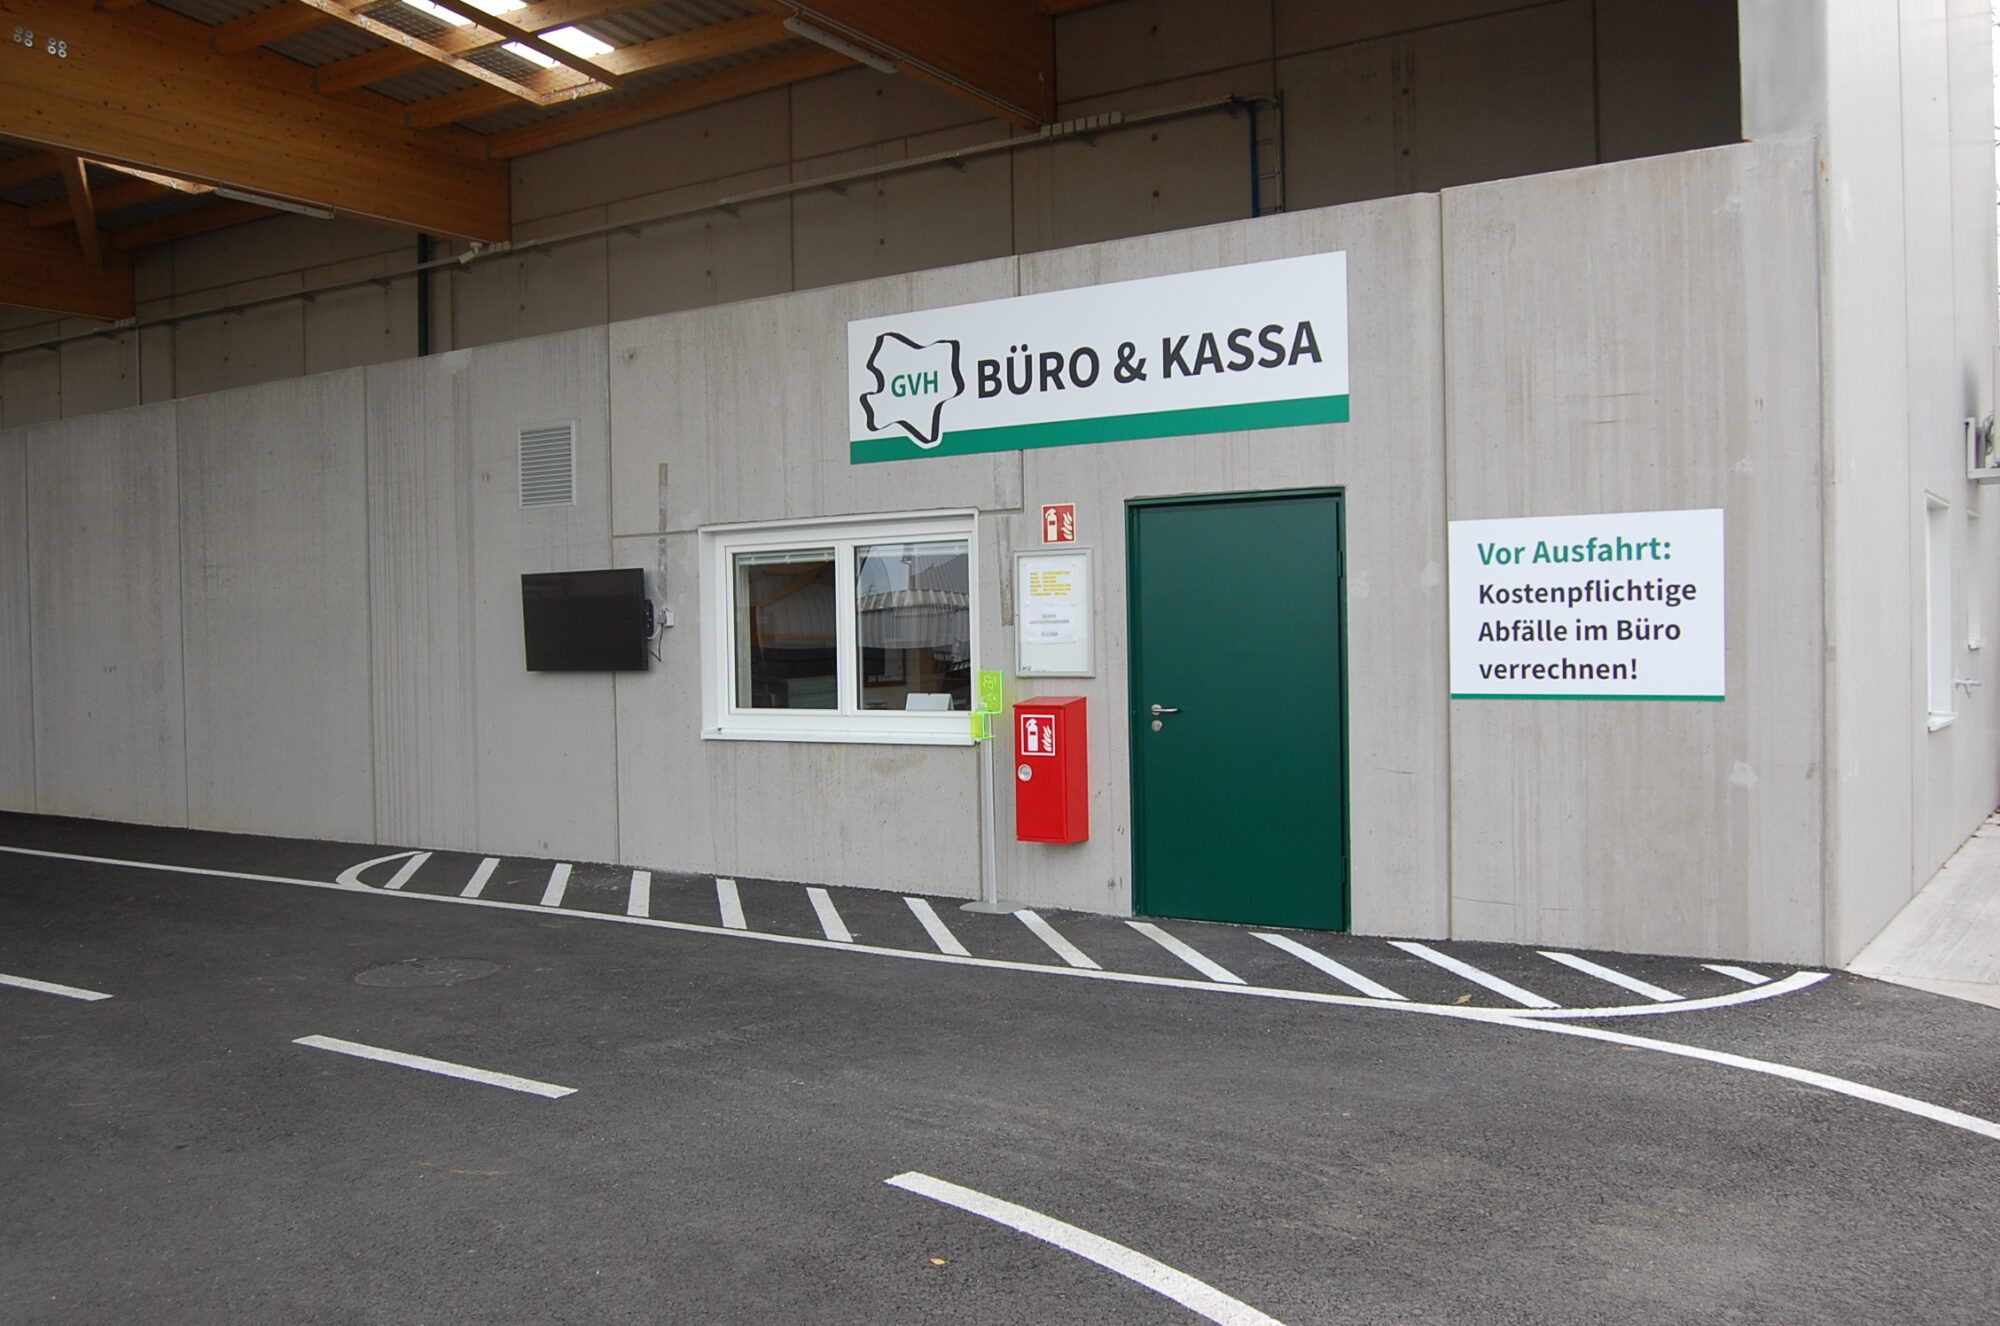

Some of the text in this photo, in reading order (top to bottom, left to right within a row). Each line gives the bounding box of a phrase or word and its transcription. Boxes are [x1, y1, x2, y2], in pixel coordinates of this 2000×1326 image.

[977, 320, 1323, 399] BÜRO & KASSA
[890, 370, 940, 398] GVH
[1477, 536, 1672, 566] Vor Ausfahrt:
[1479, 577, 1697, 609] Kostenpflichtige
[1478, 617, 1681, 642] Abfälle im Büro
[1478, 657, 1638, 680] verrechnen!
